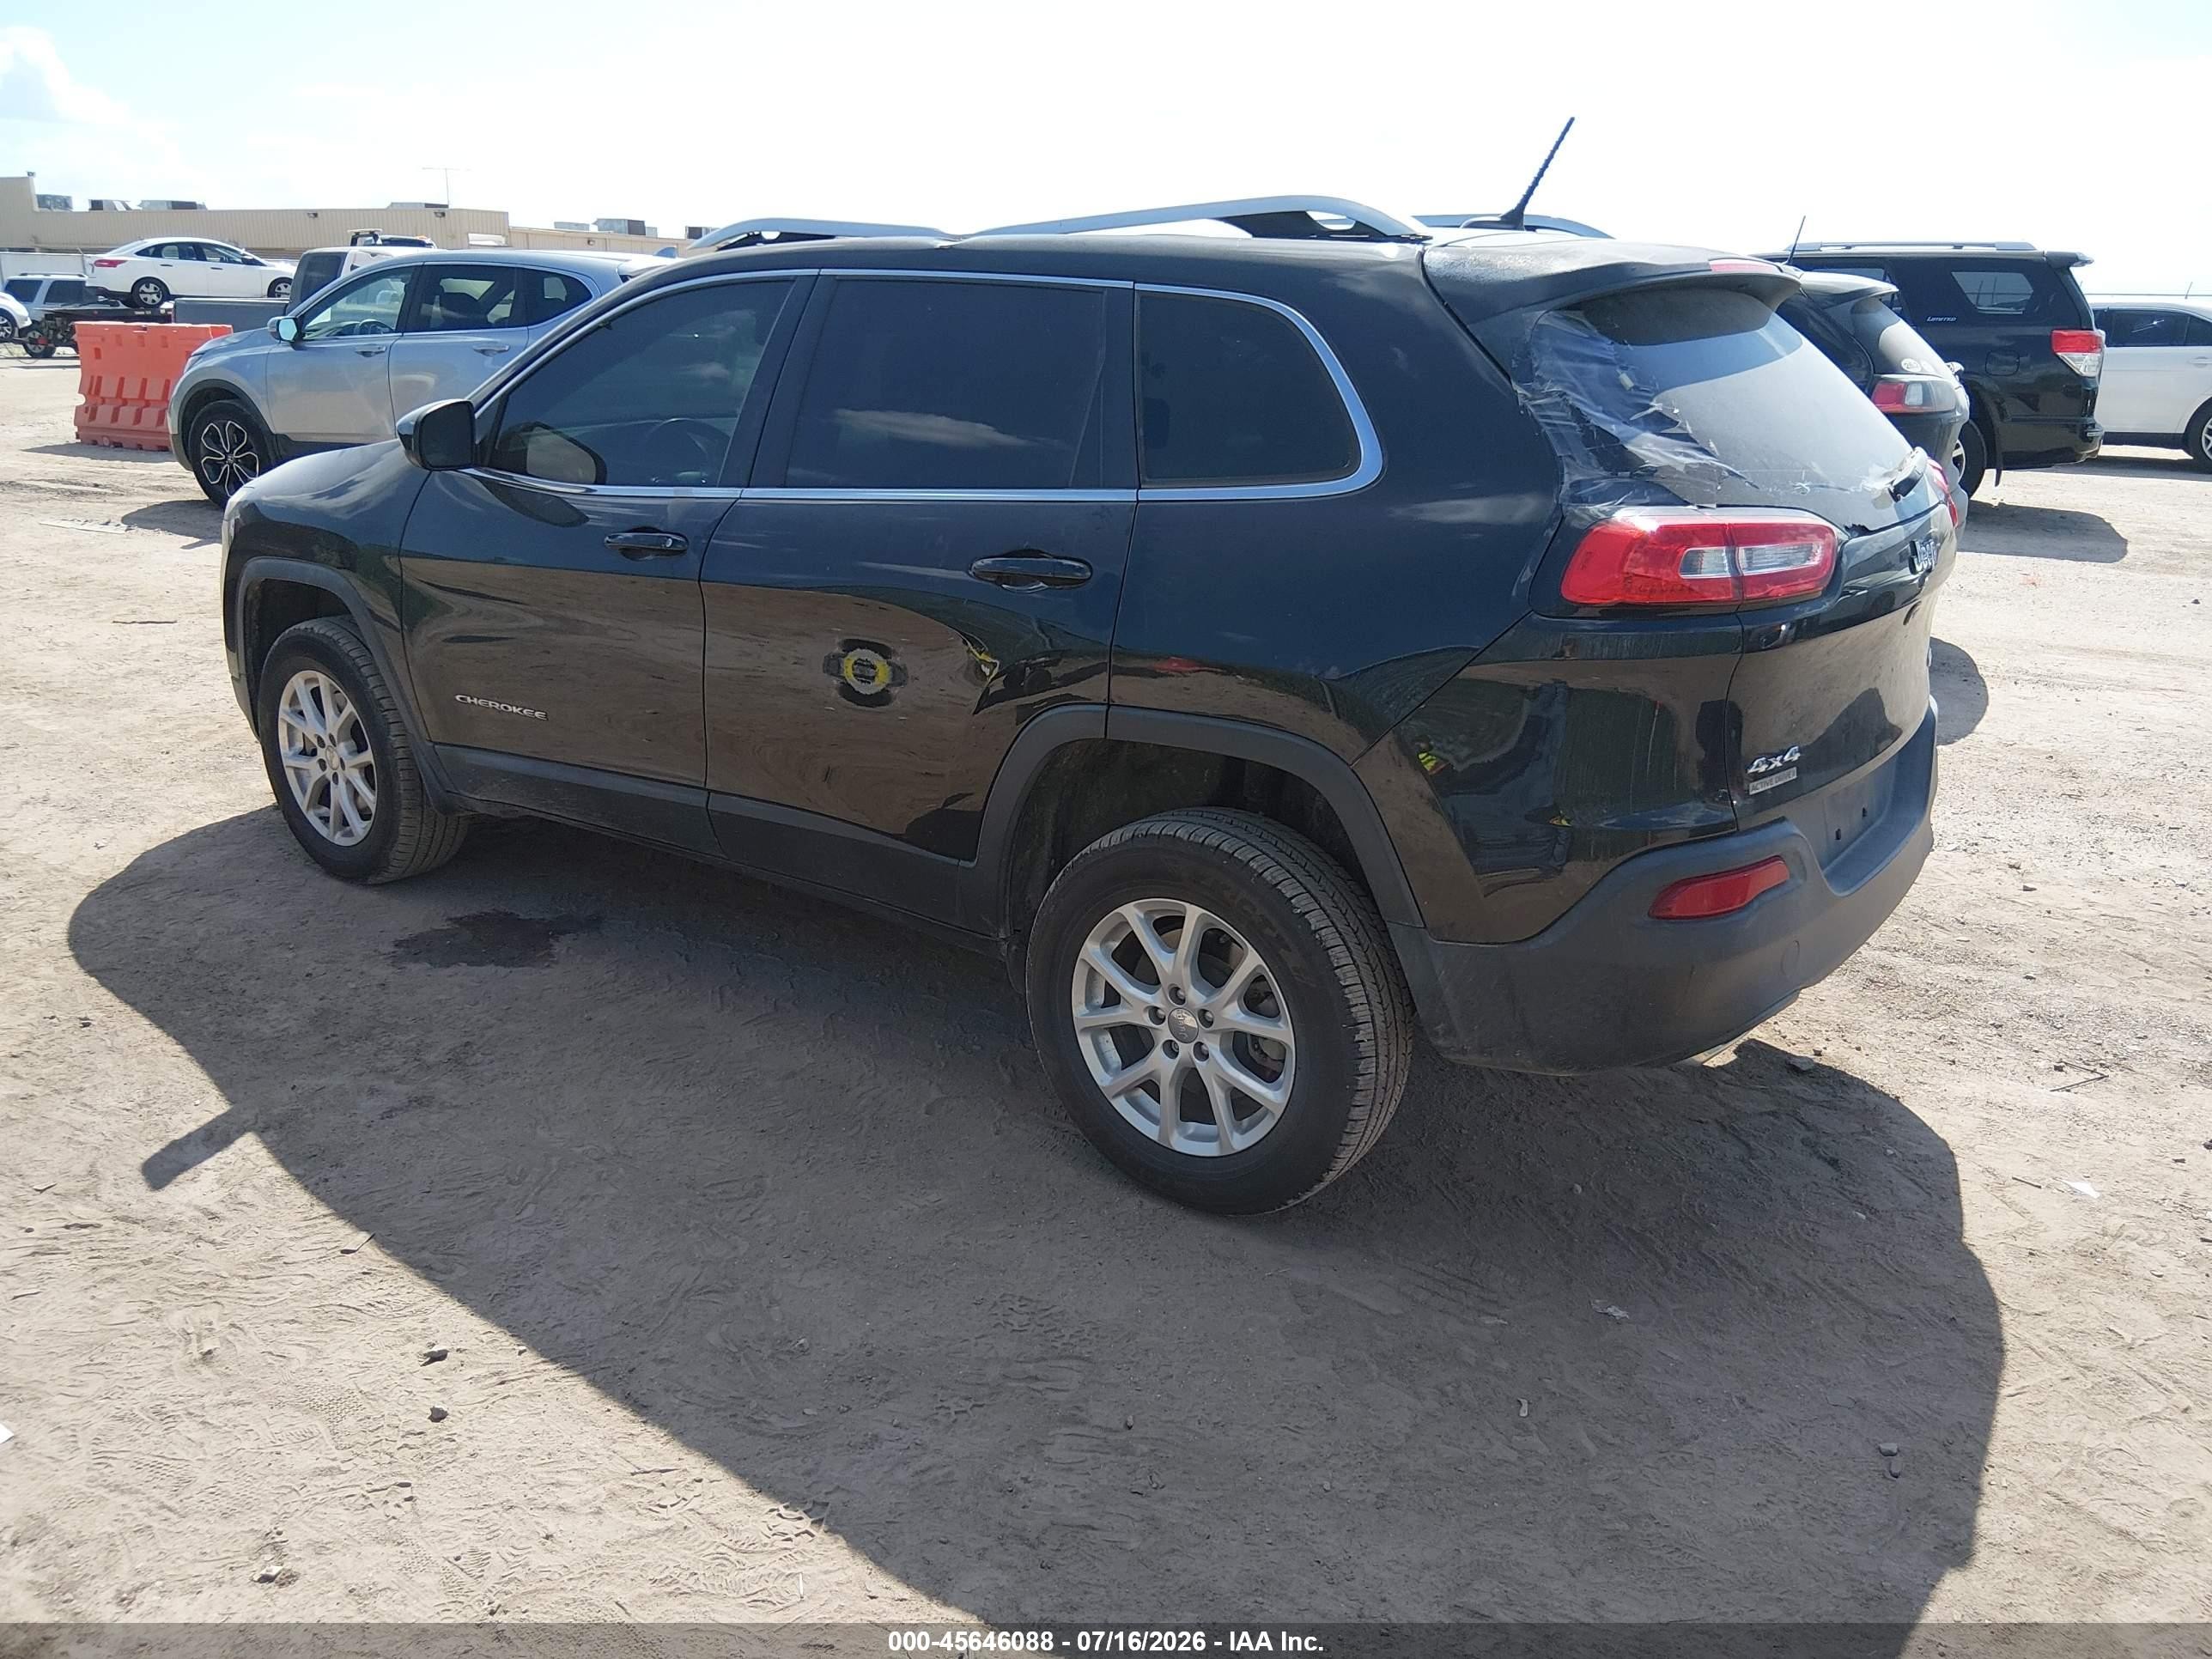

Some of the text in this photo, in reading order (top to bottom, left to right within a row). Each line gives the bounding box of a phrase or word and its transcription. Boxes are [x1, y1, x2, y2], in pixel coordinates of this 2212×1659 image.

[1909, 538, 1940, 574] Jeep
[455, 694, 548, 720] CHEROKEE
[1747, 745, 1801, 773] 4x4
